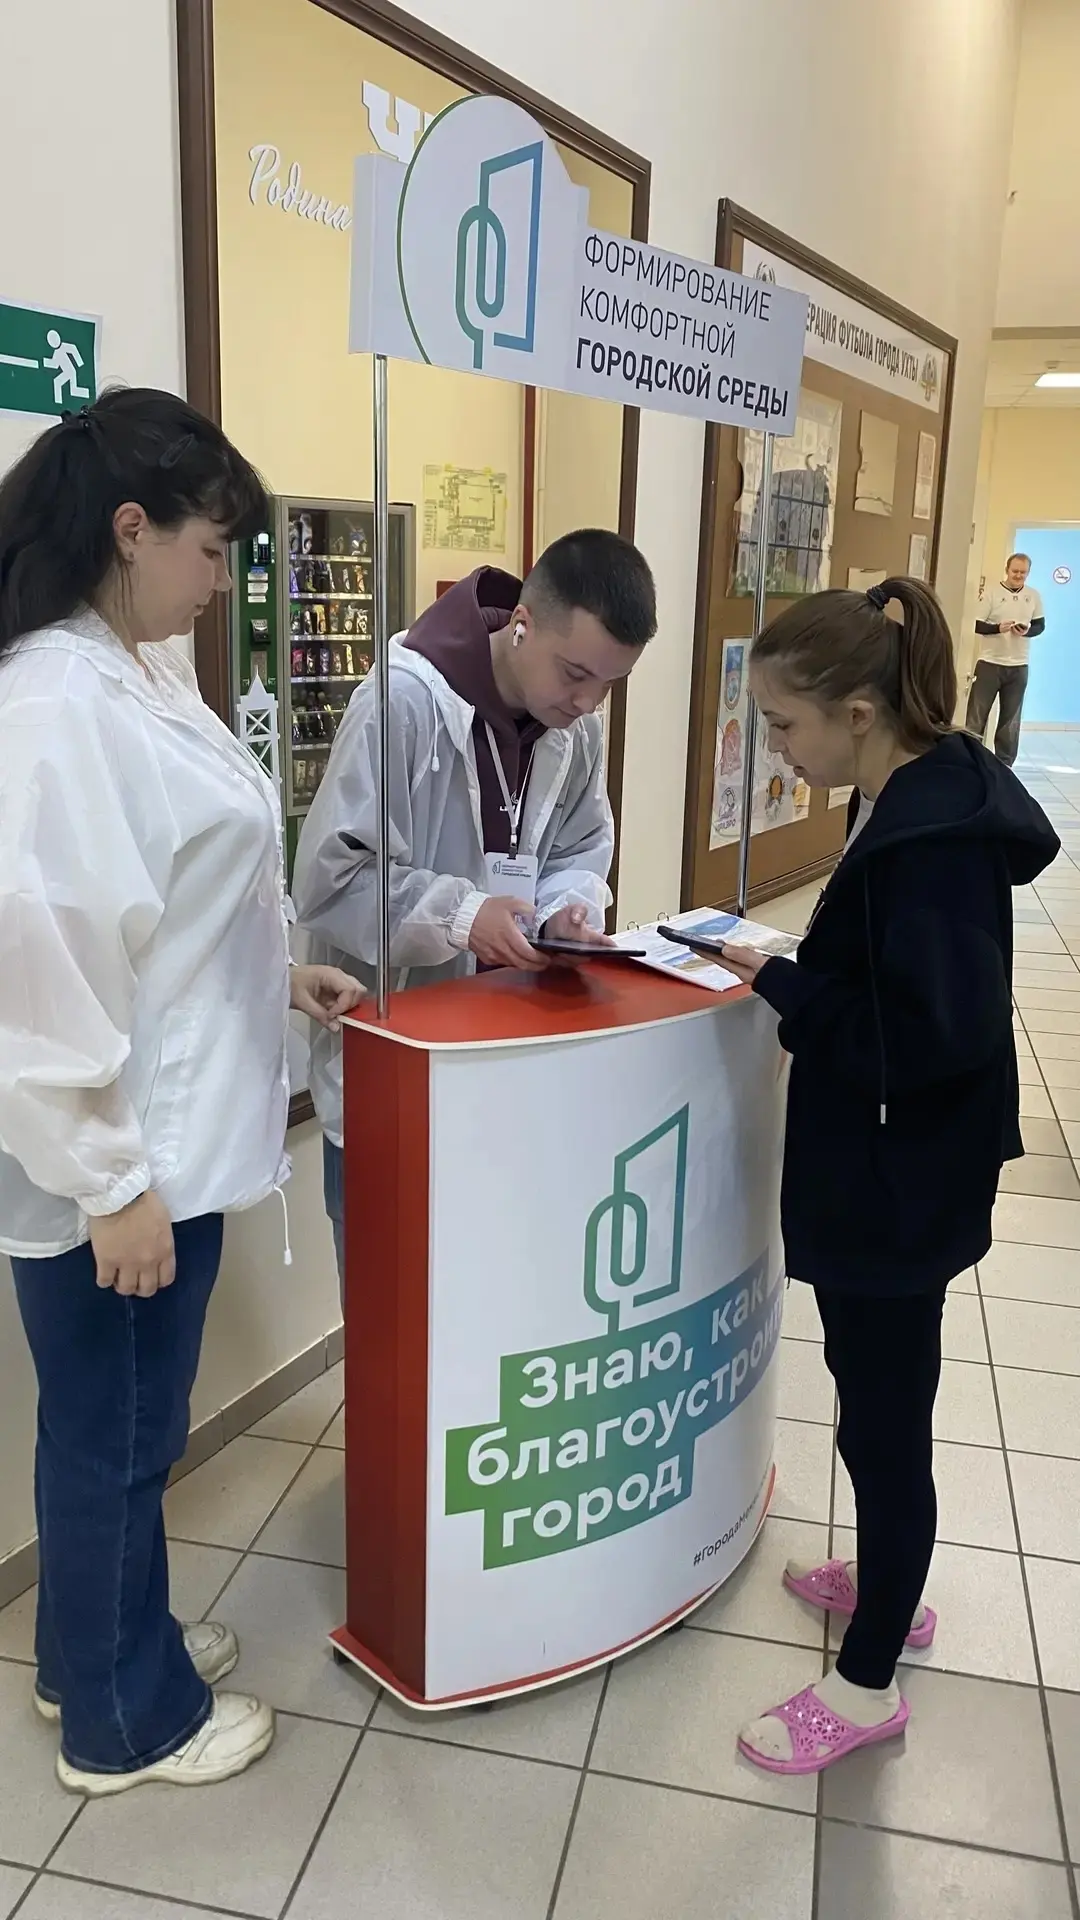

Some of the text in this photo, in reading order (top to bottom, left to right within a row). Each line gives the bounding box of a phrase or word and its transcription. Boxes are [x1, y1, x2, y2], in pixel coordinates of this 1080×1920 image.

[248, 144, 352, 231] Родина
[584, 233, 772, 322] ФОРМИРОВАНИЕ
[579, 284, 736, 359] КОМФОРТНОЙ
[838, 319, 873, 360] ФУТБОЛА
[873, 336, 900, 378] ГОРОДА
[900, 350, 919, 382] УХТЫ
[576, 337, 789, 419] ГОРОДСКОЙ СРЕДЫ
[519, 1267, 765, 1409] Знаю, как
[502, 1454, 683, 1548] город
